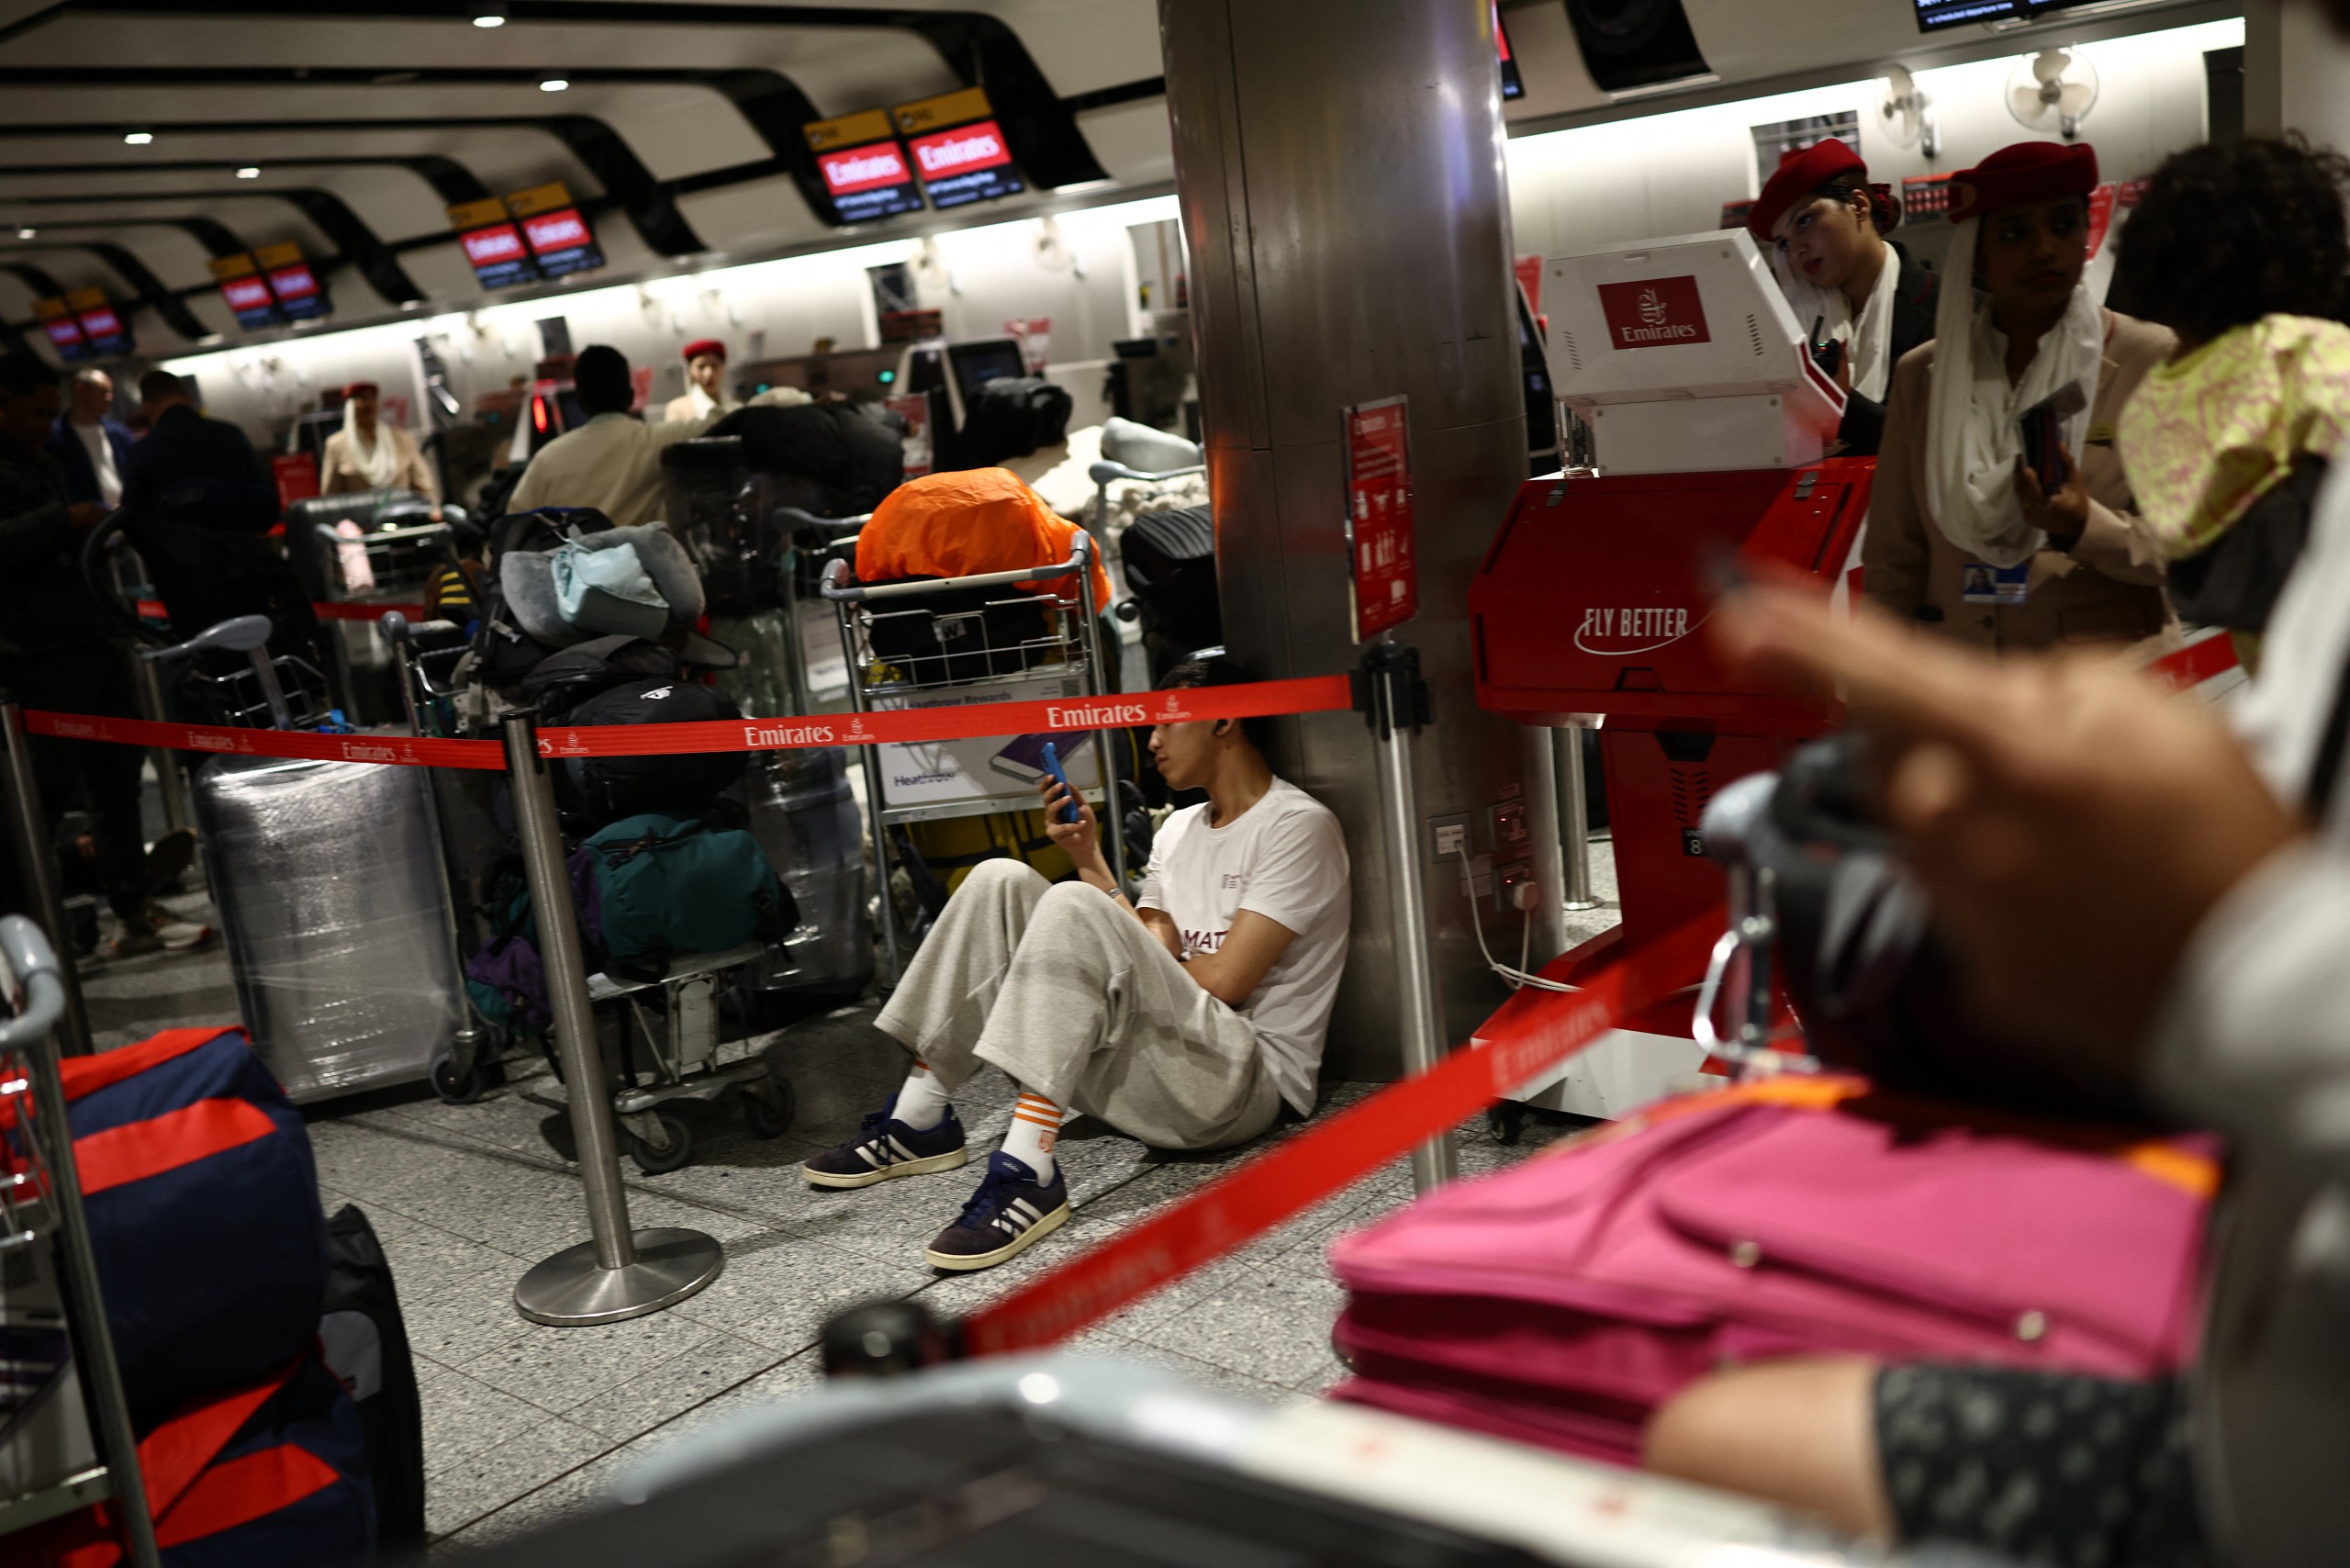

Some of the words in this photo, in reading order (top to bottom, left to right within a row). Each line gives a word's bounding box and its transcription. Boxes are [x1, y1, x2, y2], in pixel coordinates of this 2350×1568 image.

[918, 134, 1001, 171] Emirates
[1621, 323, 1696, 342] Emirates
[1584, 608, 1615, 636] FLY
[1619, 608, 1687, 637] BETTER
[1046, 703, 1147, 728] Emirates
[187, 731, 236, 750] Emirates
[744, 723, 834, 746] Emirates
[341, 742, 397, 761] Emirates
[894, 772, 956, 788] Heathrow
[1690, 839, 1703, 855] 8
